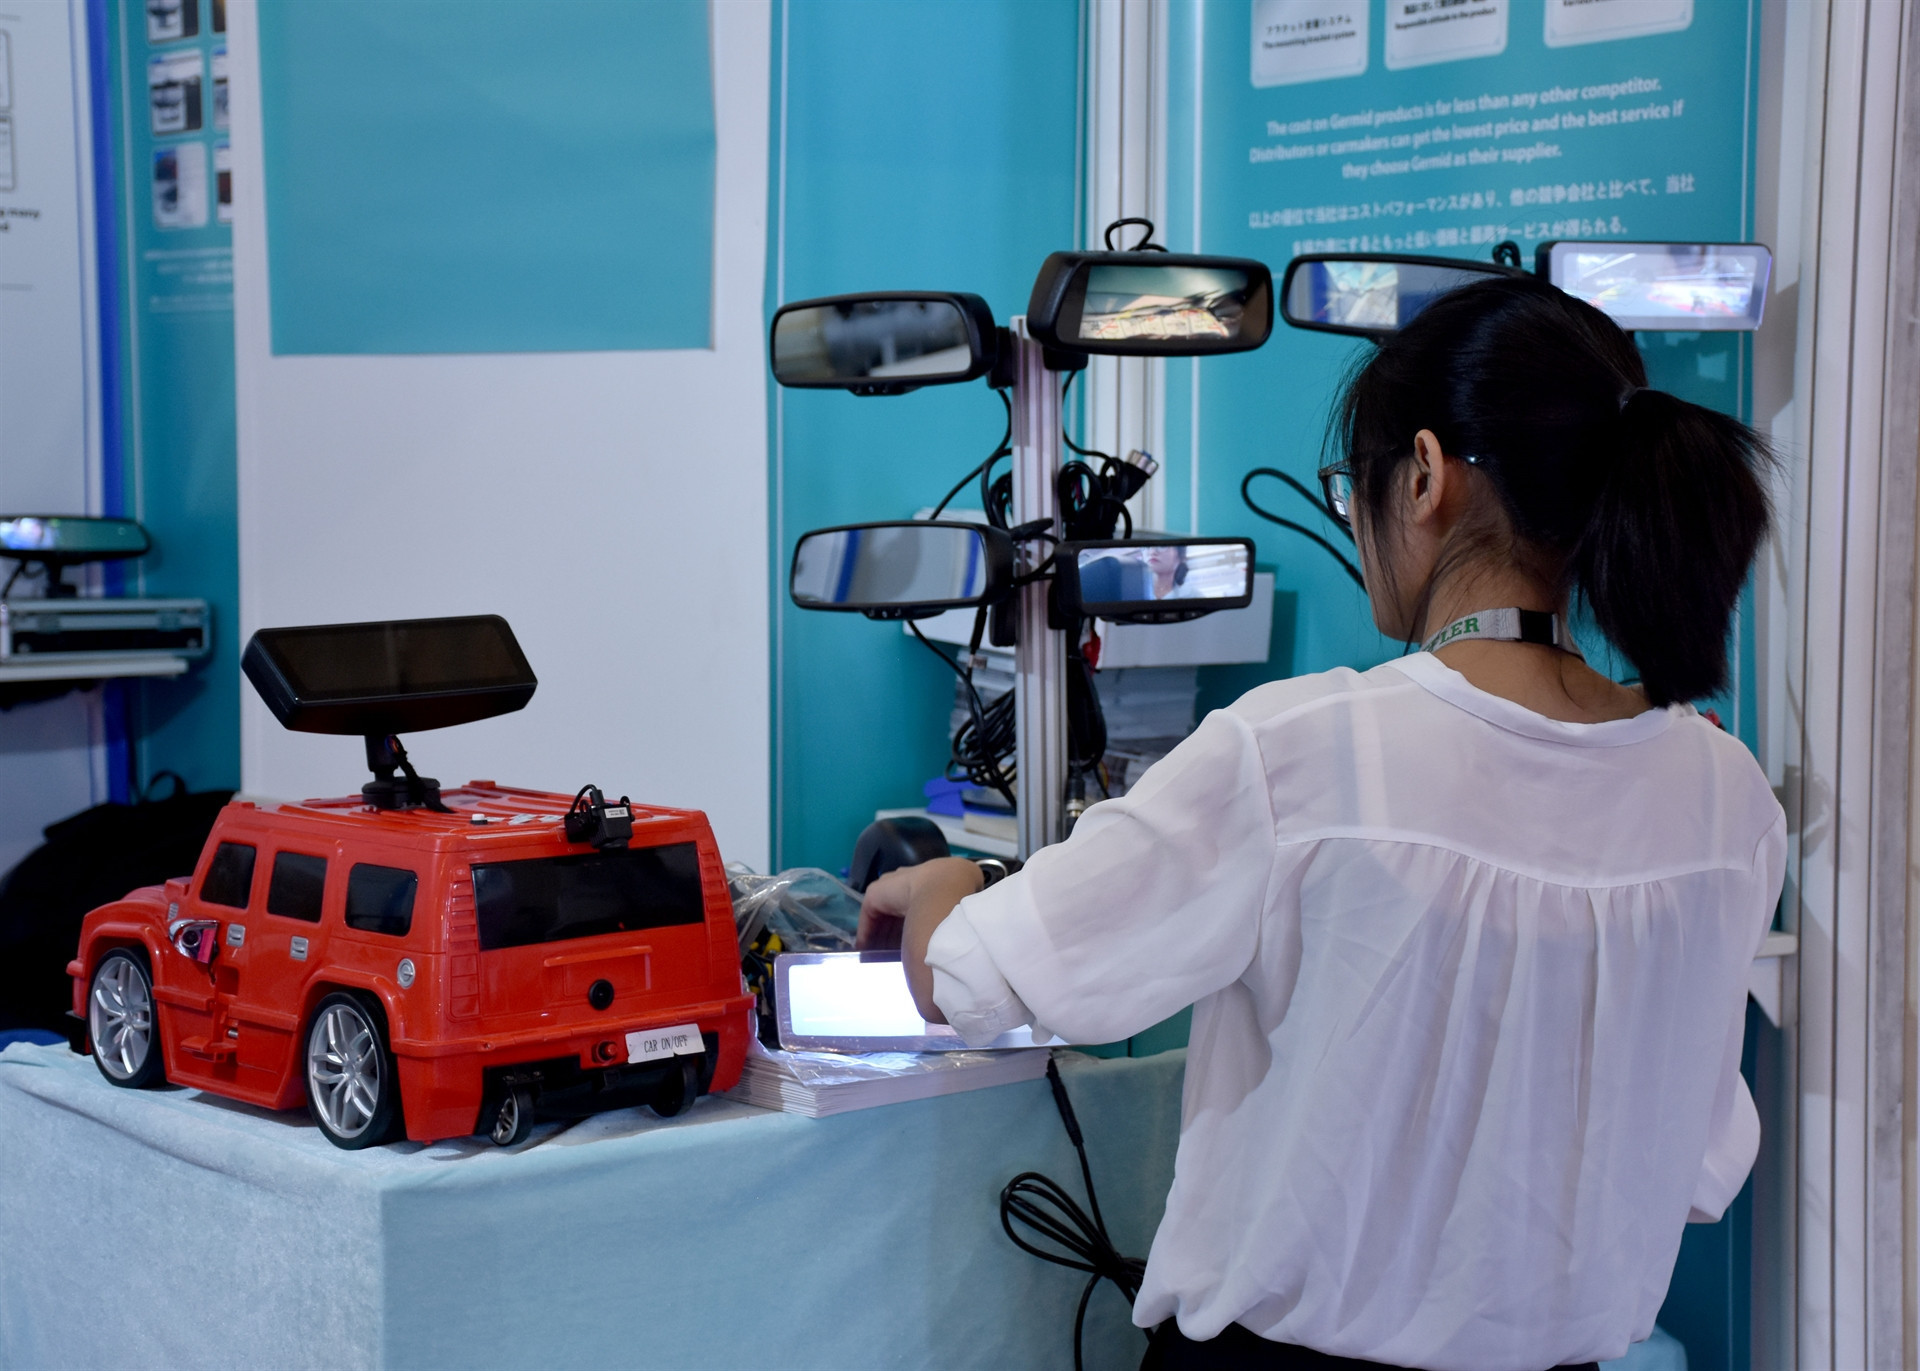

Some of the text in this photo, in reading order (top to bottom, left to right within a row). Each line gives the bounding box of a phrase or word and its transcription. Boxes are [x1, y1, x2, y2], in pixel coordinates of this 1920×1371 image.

[1250, 98, 1685, 164] Distributors or carmakers can get the lowest price and the best service if
[1267, 120, 1287, 136] The
[1313, 117, 1328, 132] on
[1375, 104, 1424, 128] products
[1425, 102, 1434, 117] is
[1436, 100, 1451, 116] far
[1453, 97, 1477, 114] less
[1479, 93, 1509, 111] than
[1511, 92, 1538, 109] any
[1540, 86, 1580, 104] other
[1581, 77, 1662, 101] competitor.
[1342, 161, 1369, 180] they
[1370, 158, 1410, 175] choose
[1453, 151, 1467, 166] as
[1469, 146, 1500, 165] their
[1502, 140, 1562, 164] supplier.
[644, 1034, 688, 1053] CAR ON/OFF
